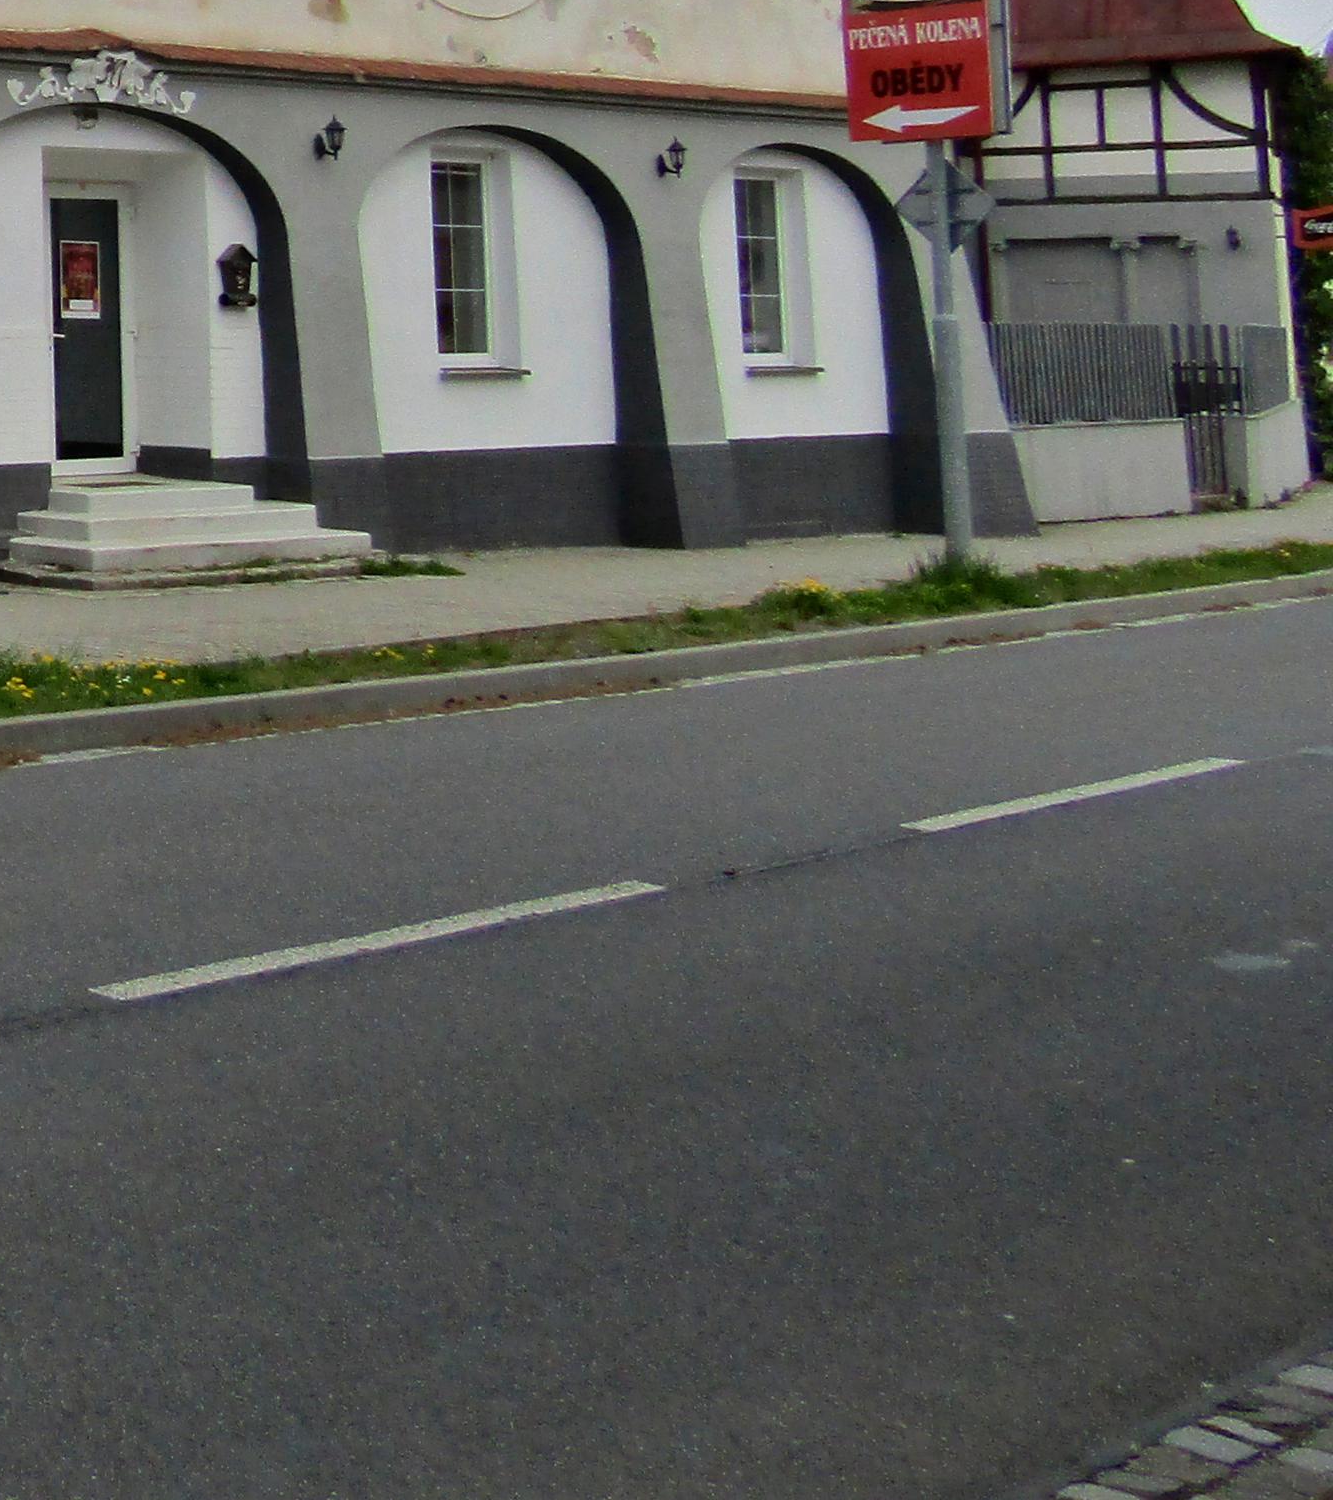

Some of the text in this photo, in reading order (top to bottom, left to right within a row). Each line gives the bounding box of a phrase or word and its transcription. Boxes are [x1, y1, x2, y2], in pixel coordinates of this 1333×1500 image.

[848, 16, 982, 50] PEČENÁ KOLENA
[870, 60, 964, 98] OBĚDY
